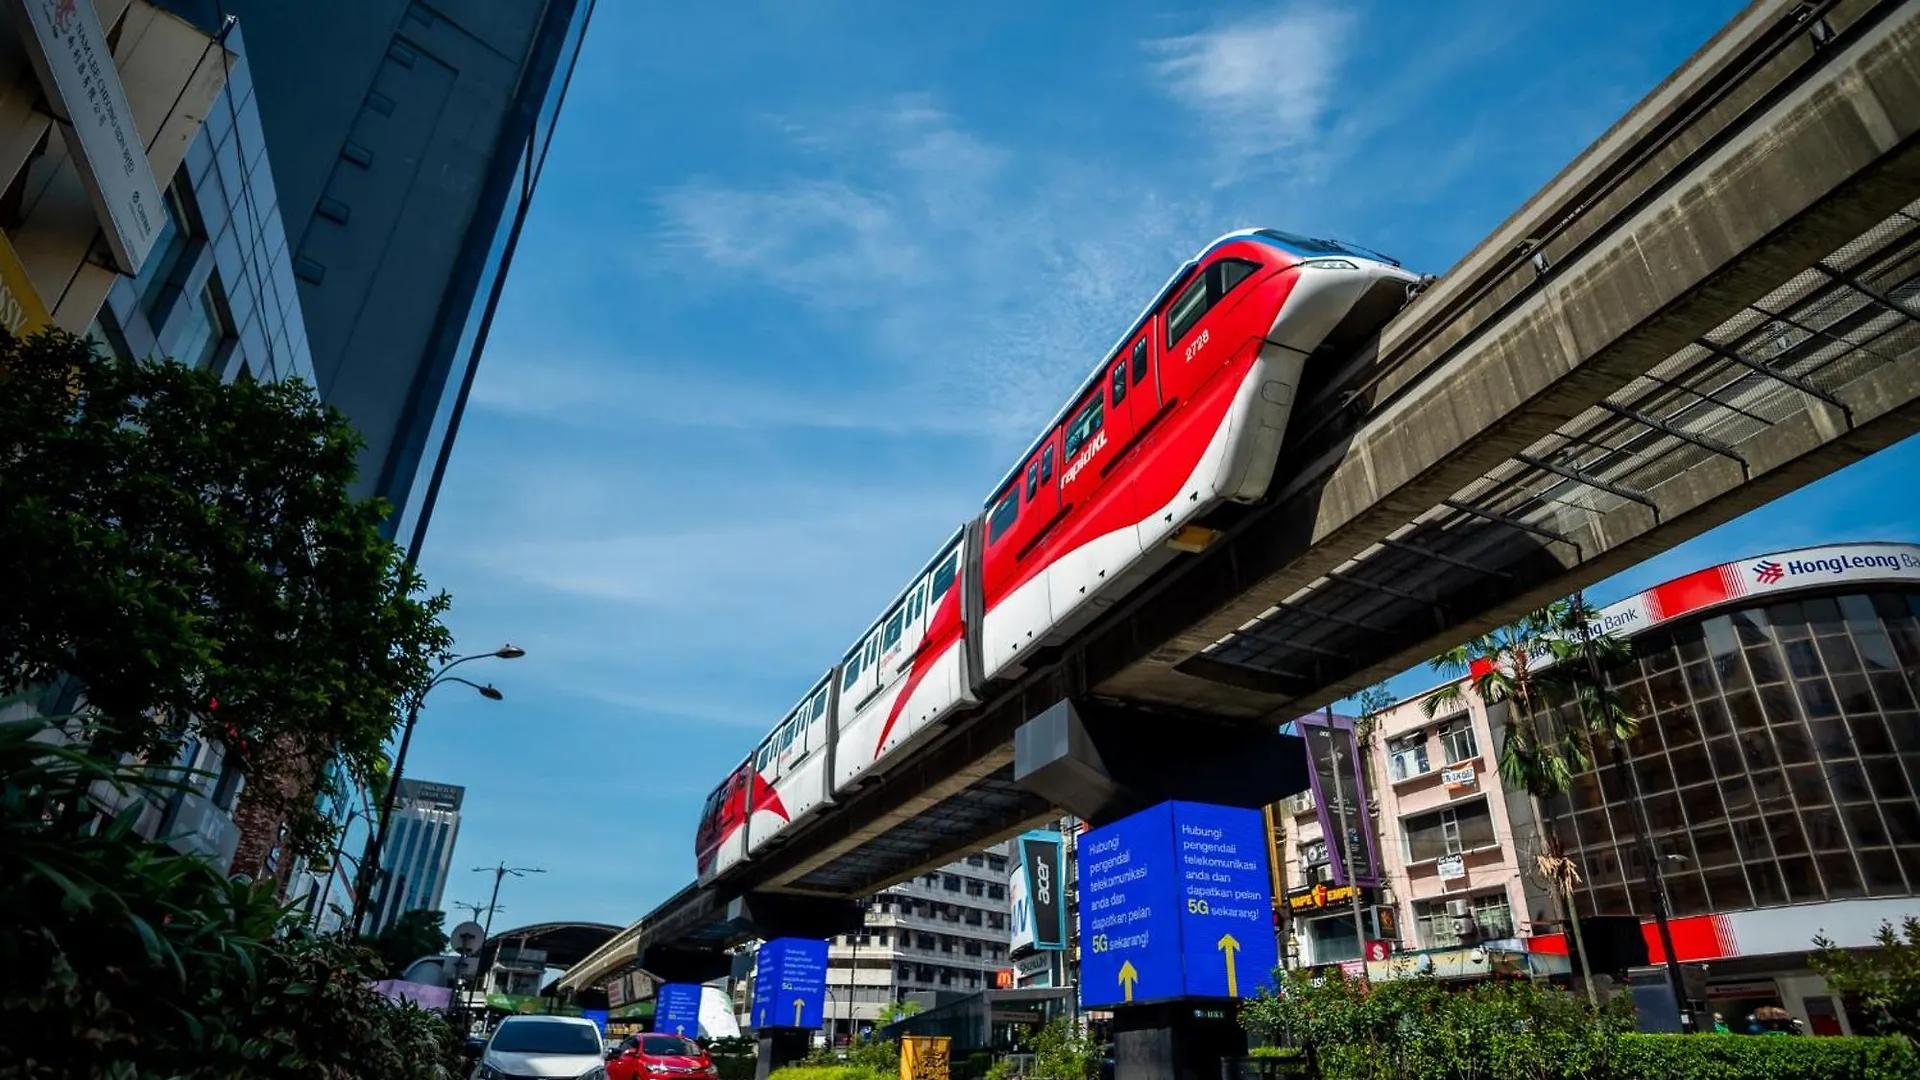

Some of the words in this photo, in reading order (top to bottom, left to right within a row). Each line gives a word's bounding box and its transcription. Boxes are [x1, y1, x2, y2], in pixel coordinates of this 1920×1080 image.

[1185, 329, 1209, 362] 2728
[1060, 429, 1108, 489] rapidKL
[1604, 608, 1638, 630] Bank
[1182, 824, 1222, 840] Hubungi
[1089, 834, 1119, 856] Hubungi
[1183, 841, 1237, 854] pengendali
[1090, 849, 1130, 877] pengendali
[1184, 854, 1257, 870] telekomunikasi
[1037, 855, 1050, 905] acer
[1090, 863, 1147, 892] telekomunikasi
[1185, 869, 1210, 881] anda
[1211, 871, 1231, 883] dan
[1091, 896, 1110, 911] anda
[1110, 892, 1126, 906] dan
[1186, 885, 1233, 898] dapatkan
[1234, 889, 1262, 901] pelan
[1290, 894, 1313, 909] VAPE
[1092, 912, 1128, 932] dapatkan
[1128, 906, 1152, 924] pelan
[1187, 898, 1209, 915] 5G
[1211, 905, 1260, 921] sekarang!
[1092, 933, 1108, 953] 5G
[1109, 929, 1149, 951] sekarang!
